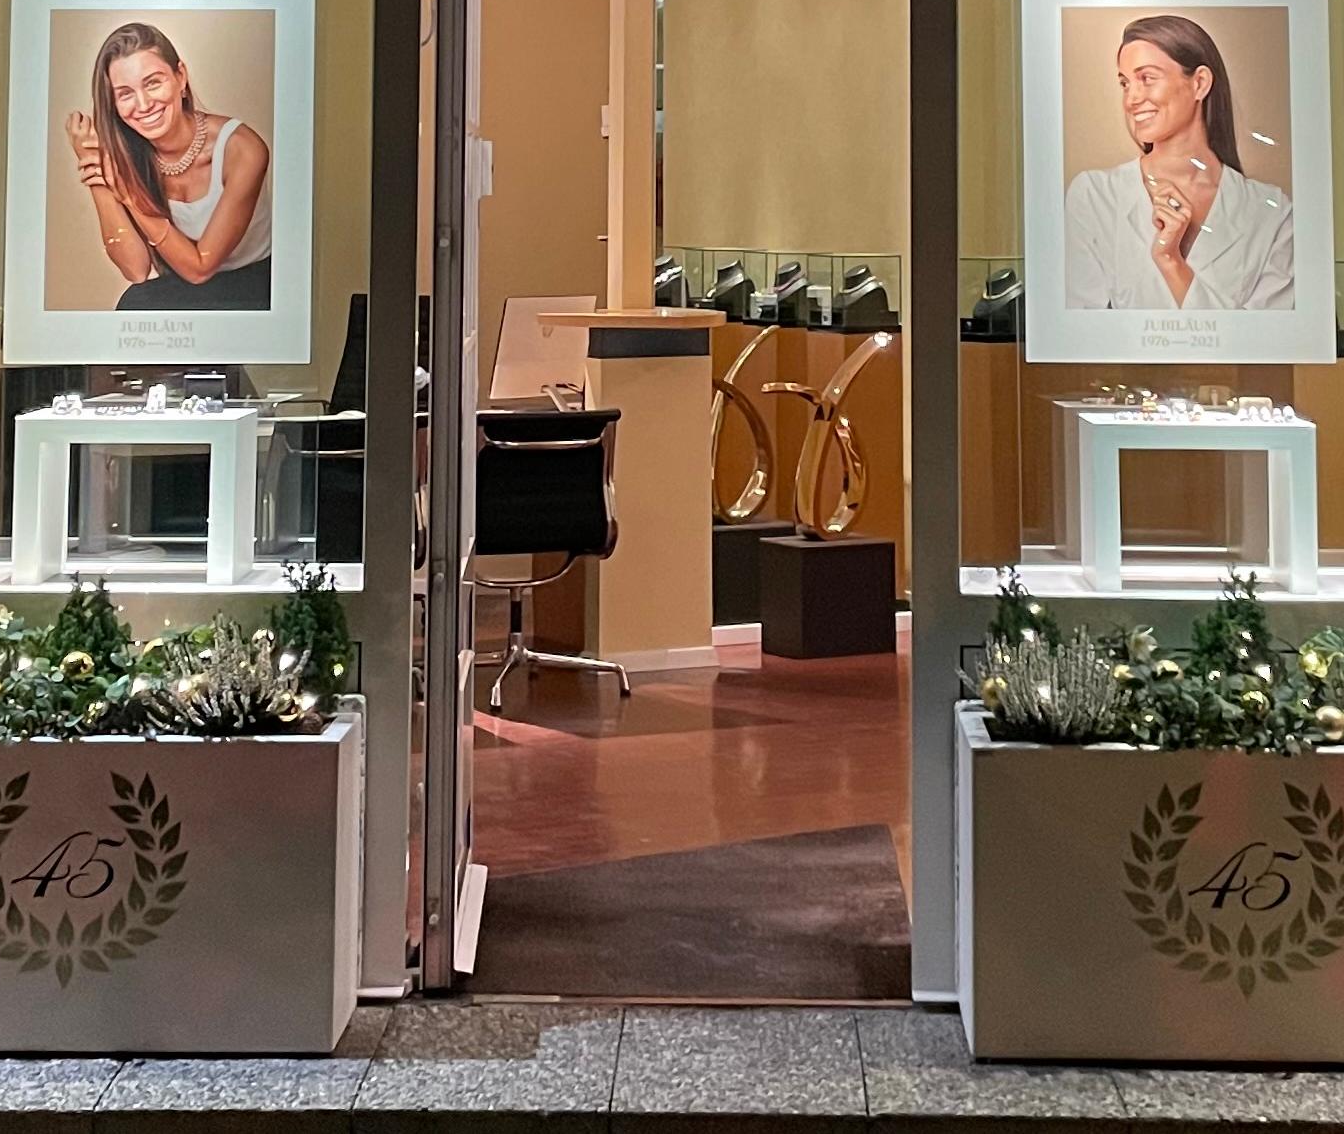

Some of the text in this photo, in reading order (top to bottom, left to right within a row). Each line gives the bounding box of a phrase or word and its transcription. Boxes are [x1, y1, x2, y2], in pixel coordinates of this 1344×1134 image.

[120, 319, 193, 333] JUBILÄUM
[1144, 318, 1217, 332] JUBILÄUM
[11, 831, 126, 898] 45
[1188, 842, 1303, 911] 45
